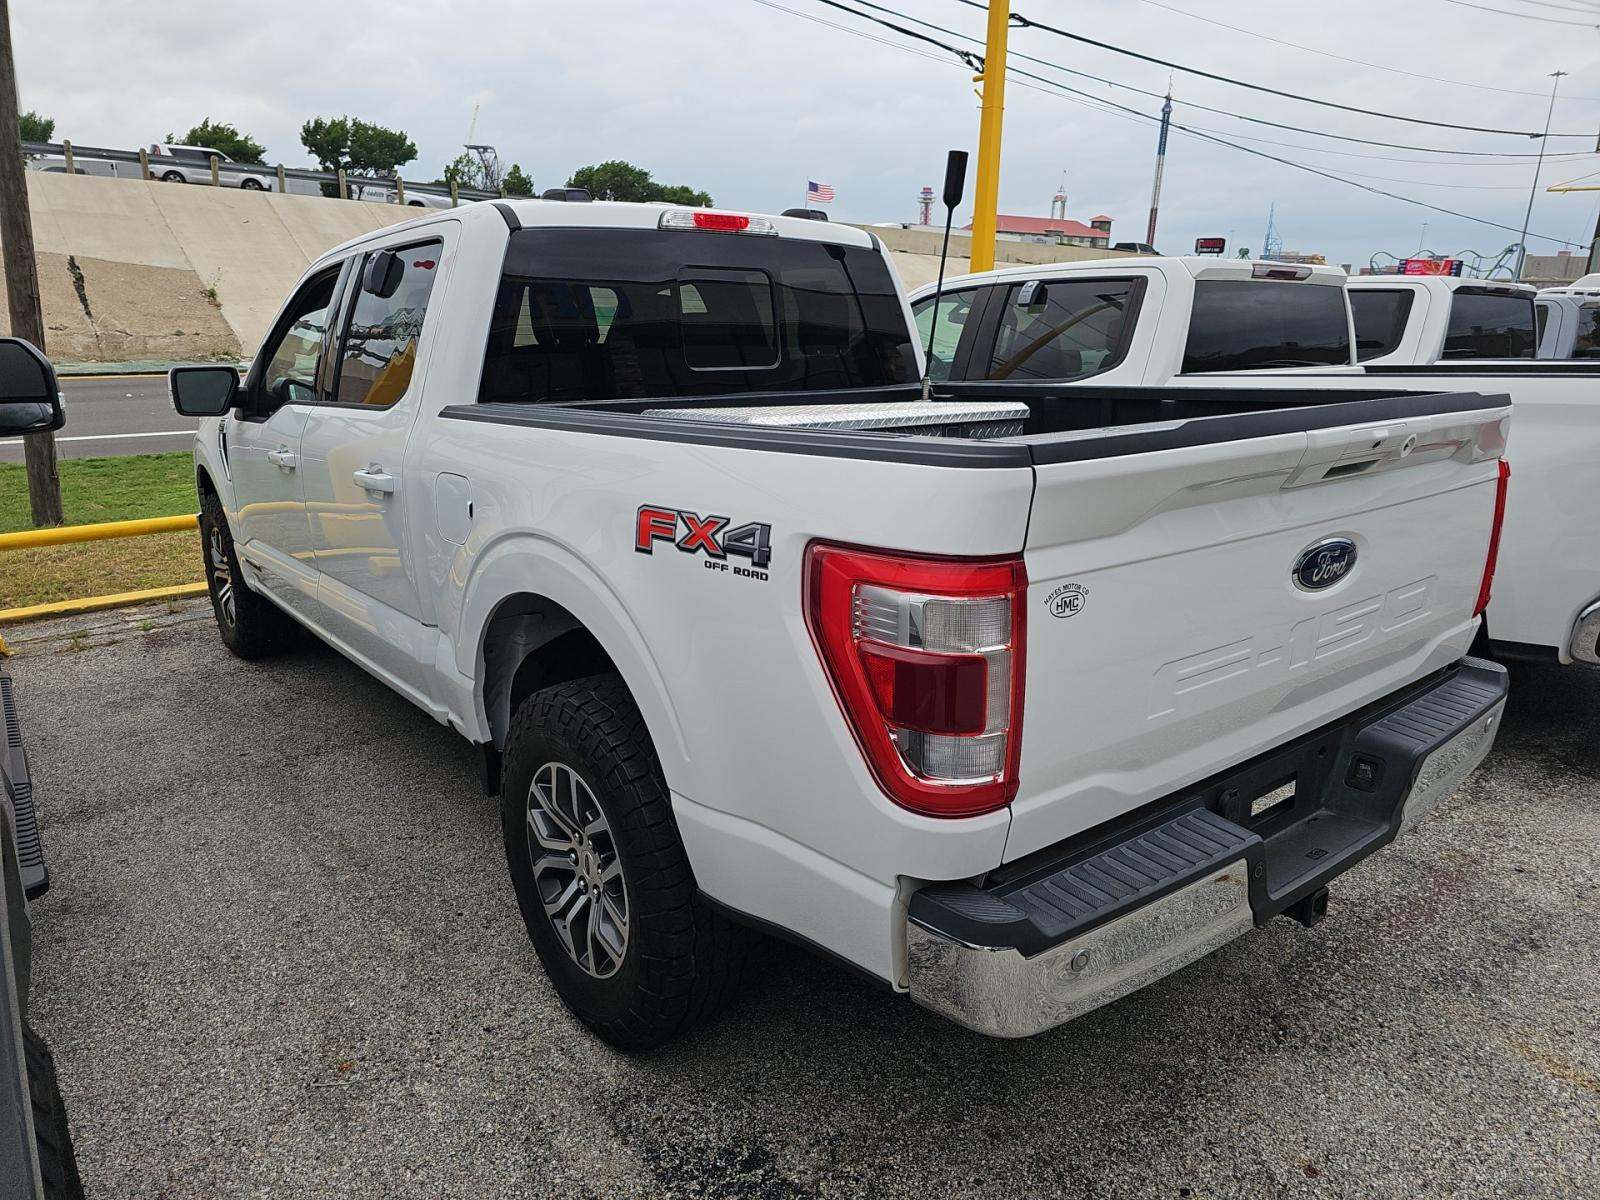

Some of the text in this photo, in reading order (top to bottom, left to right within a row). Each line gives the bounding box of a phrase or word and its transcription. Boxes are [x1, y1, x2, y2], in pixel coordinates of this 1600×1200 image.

[634, 503, 772, 570] FX4
[704, 560, 769, 582] OFF ROAD
[1312, 549, 1348, 582] Ford
[1043, 586, 1062, 606] HAYES
[1062, 583, 1082, 591] MOTOR
[1055, 594, 1079, 614] HMC
